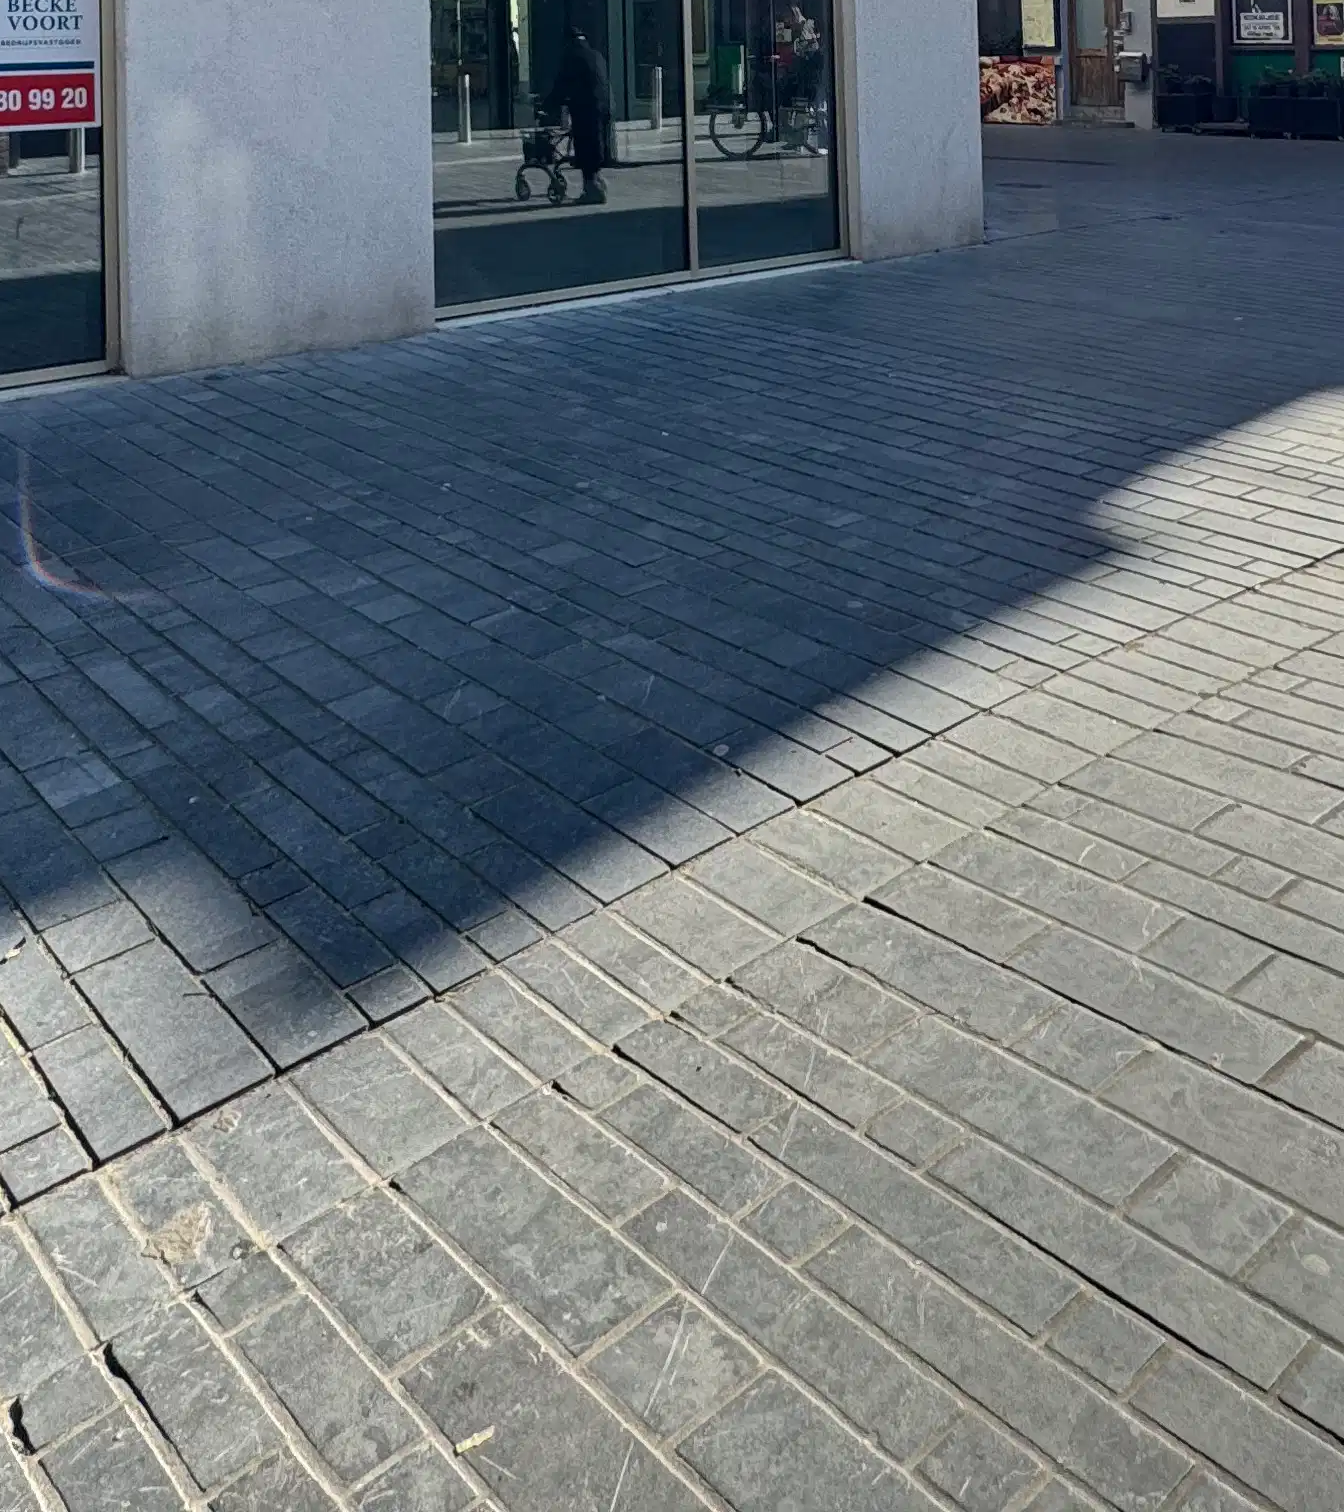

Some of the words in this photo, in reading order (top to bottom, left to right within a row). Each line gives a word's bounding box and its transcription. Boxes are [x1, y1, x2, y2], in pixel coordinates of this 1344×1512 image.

[7, 14, 84, 31] VOORT
[28, 88, 55, 110] 99
[61, 87, 88, 109] 20
